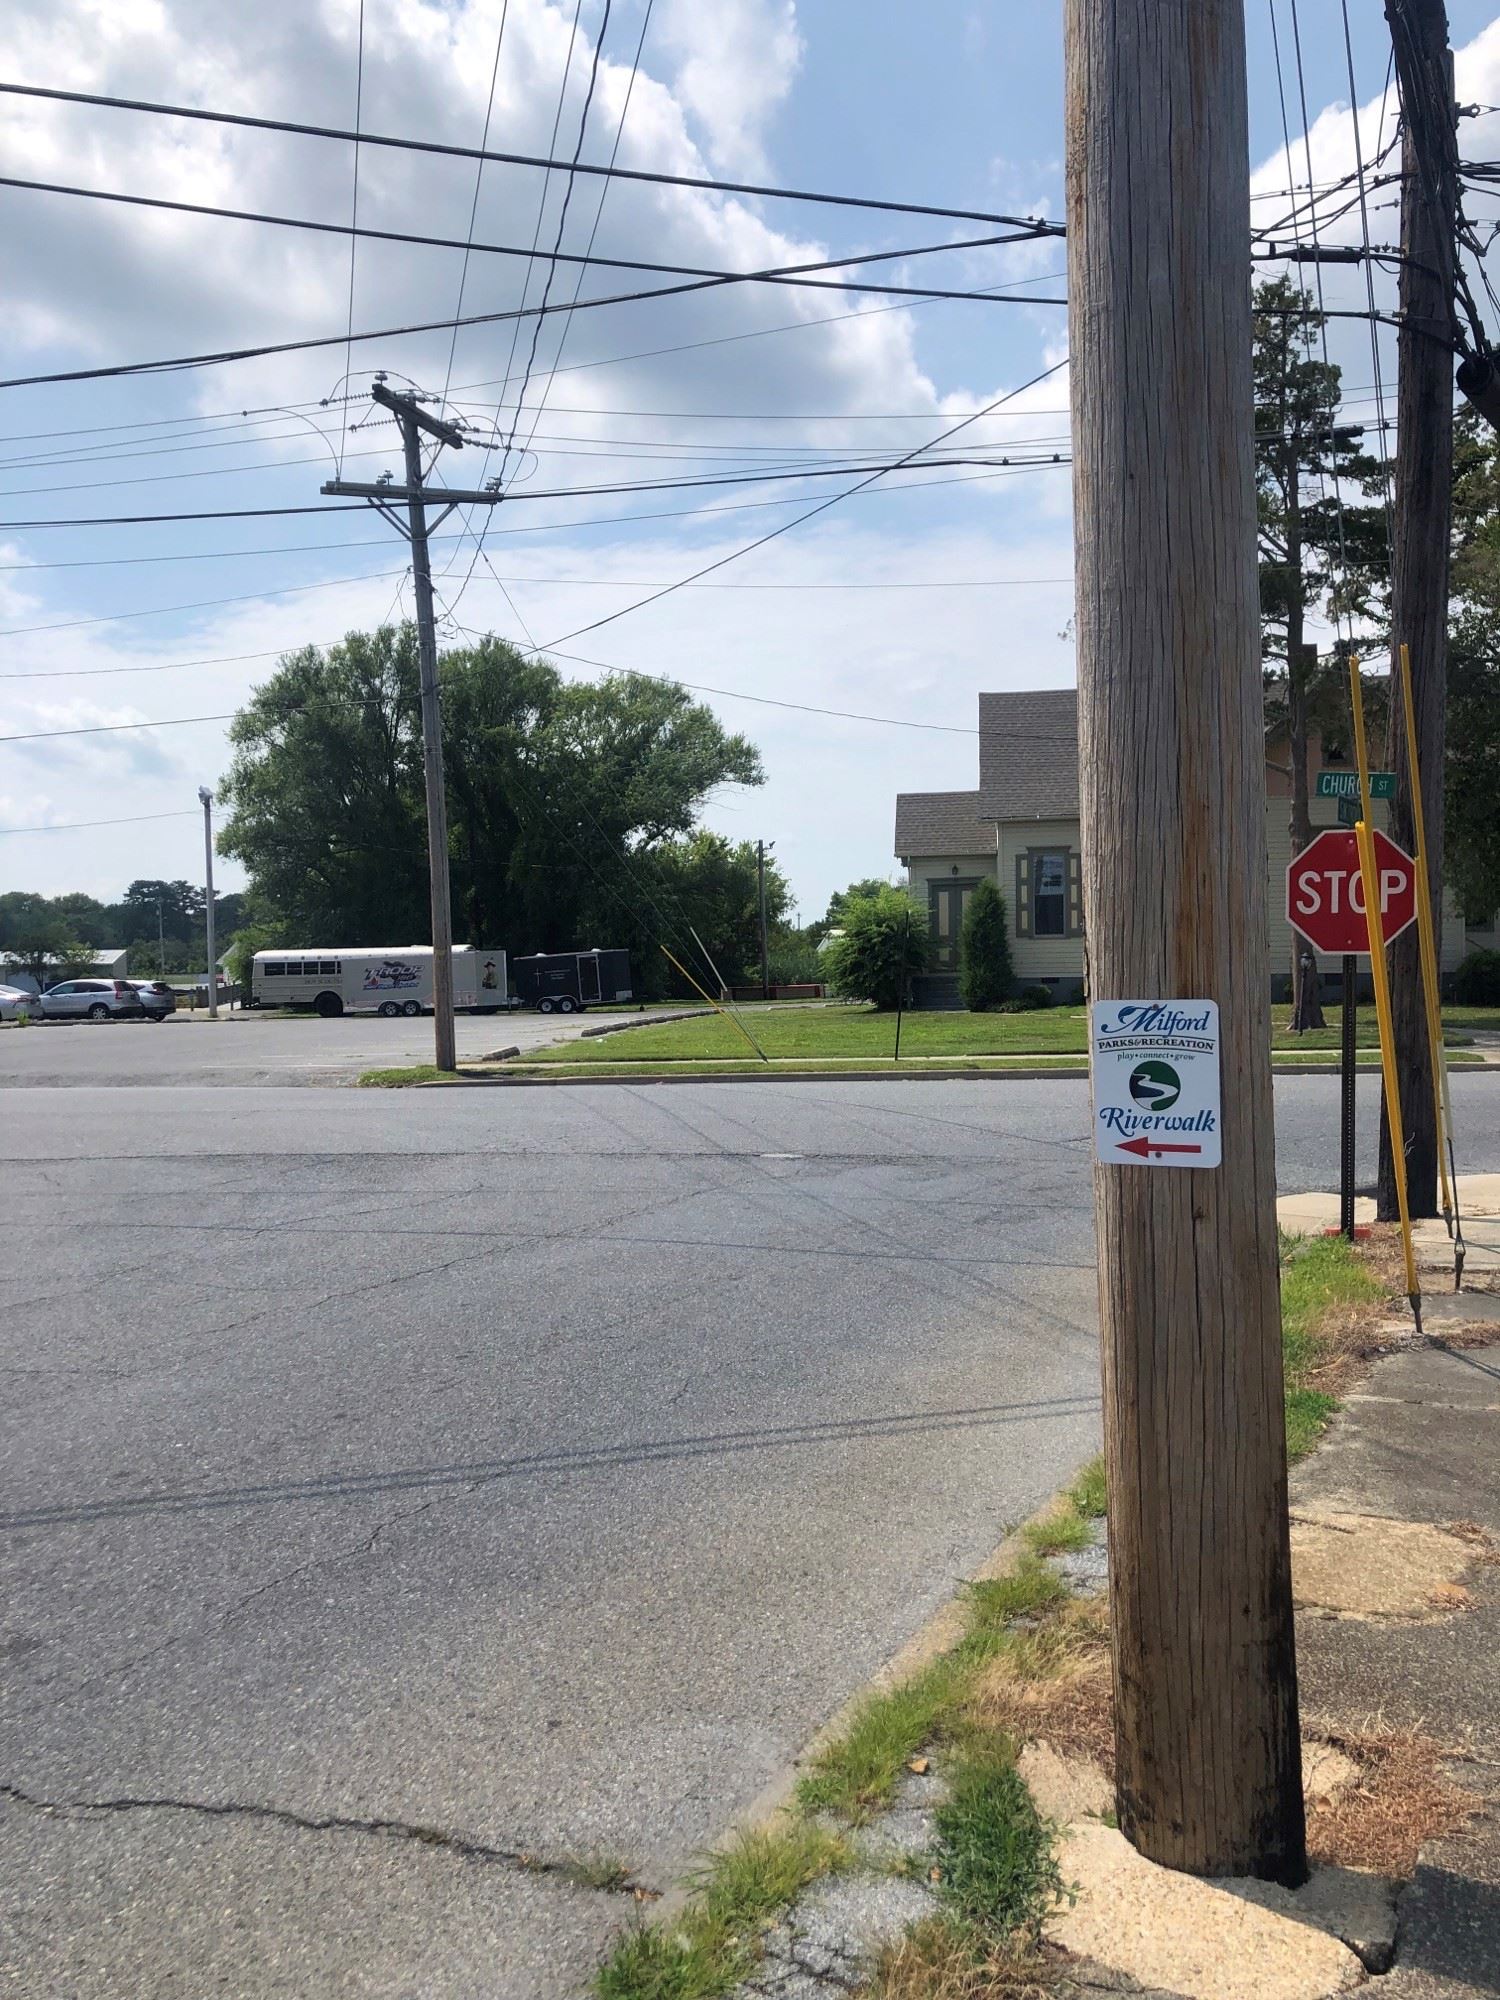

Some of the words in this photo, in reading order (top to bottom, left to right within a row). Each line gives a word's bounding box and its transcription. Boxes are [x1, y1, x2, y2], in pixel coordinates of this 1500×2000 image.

[1378, 780, 1388, 791] ST
[1296, 869, 1408, 915] STOP
[1101, 1003, 1211, 1038] Milford
[1099, 1107, 1216, 1137] Riverwalk
